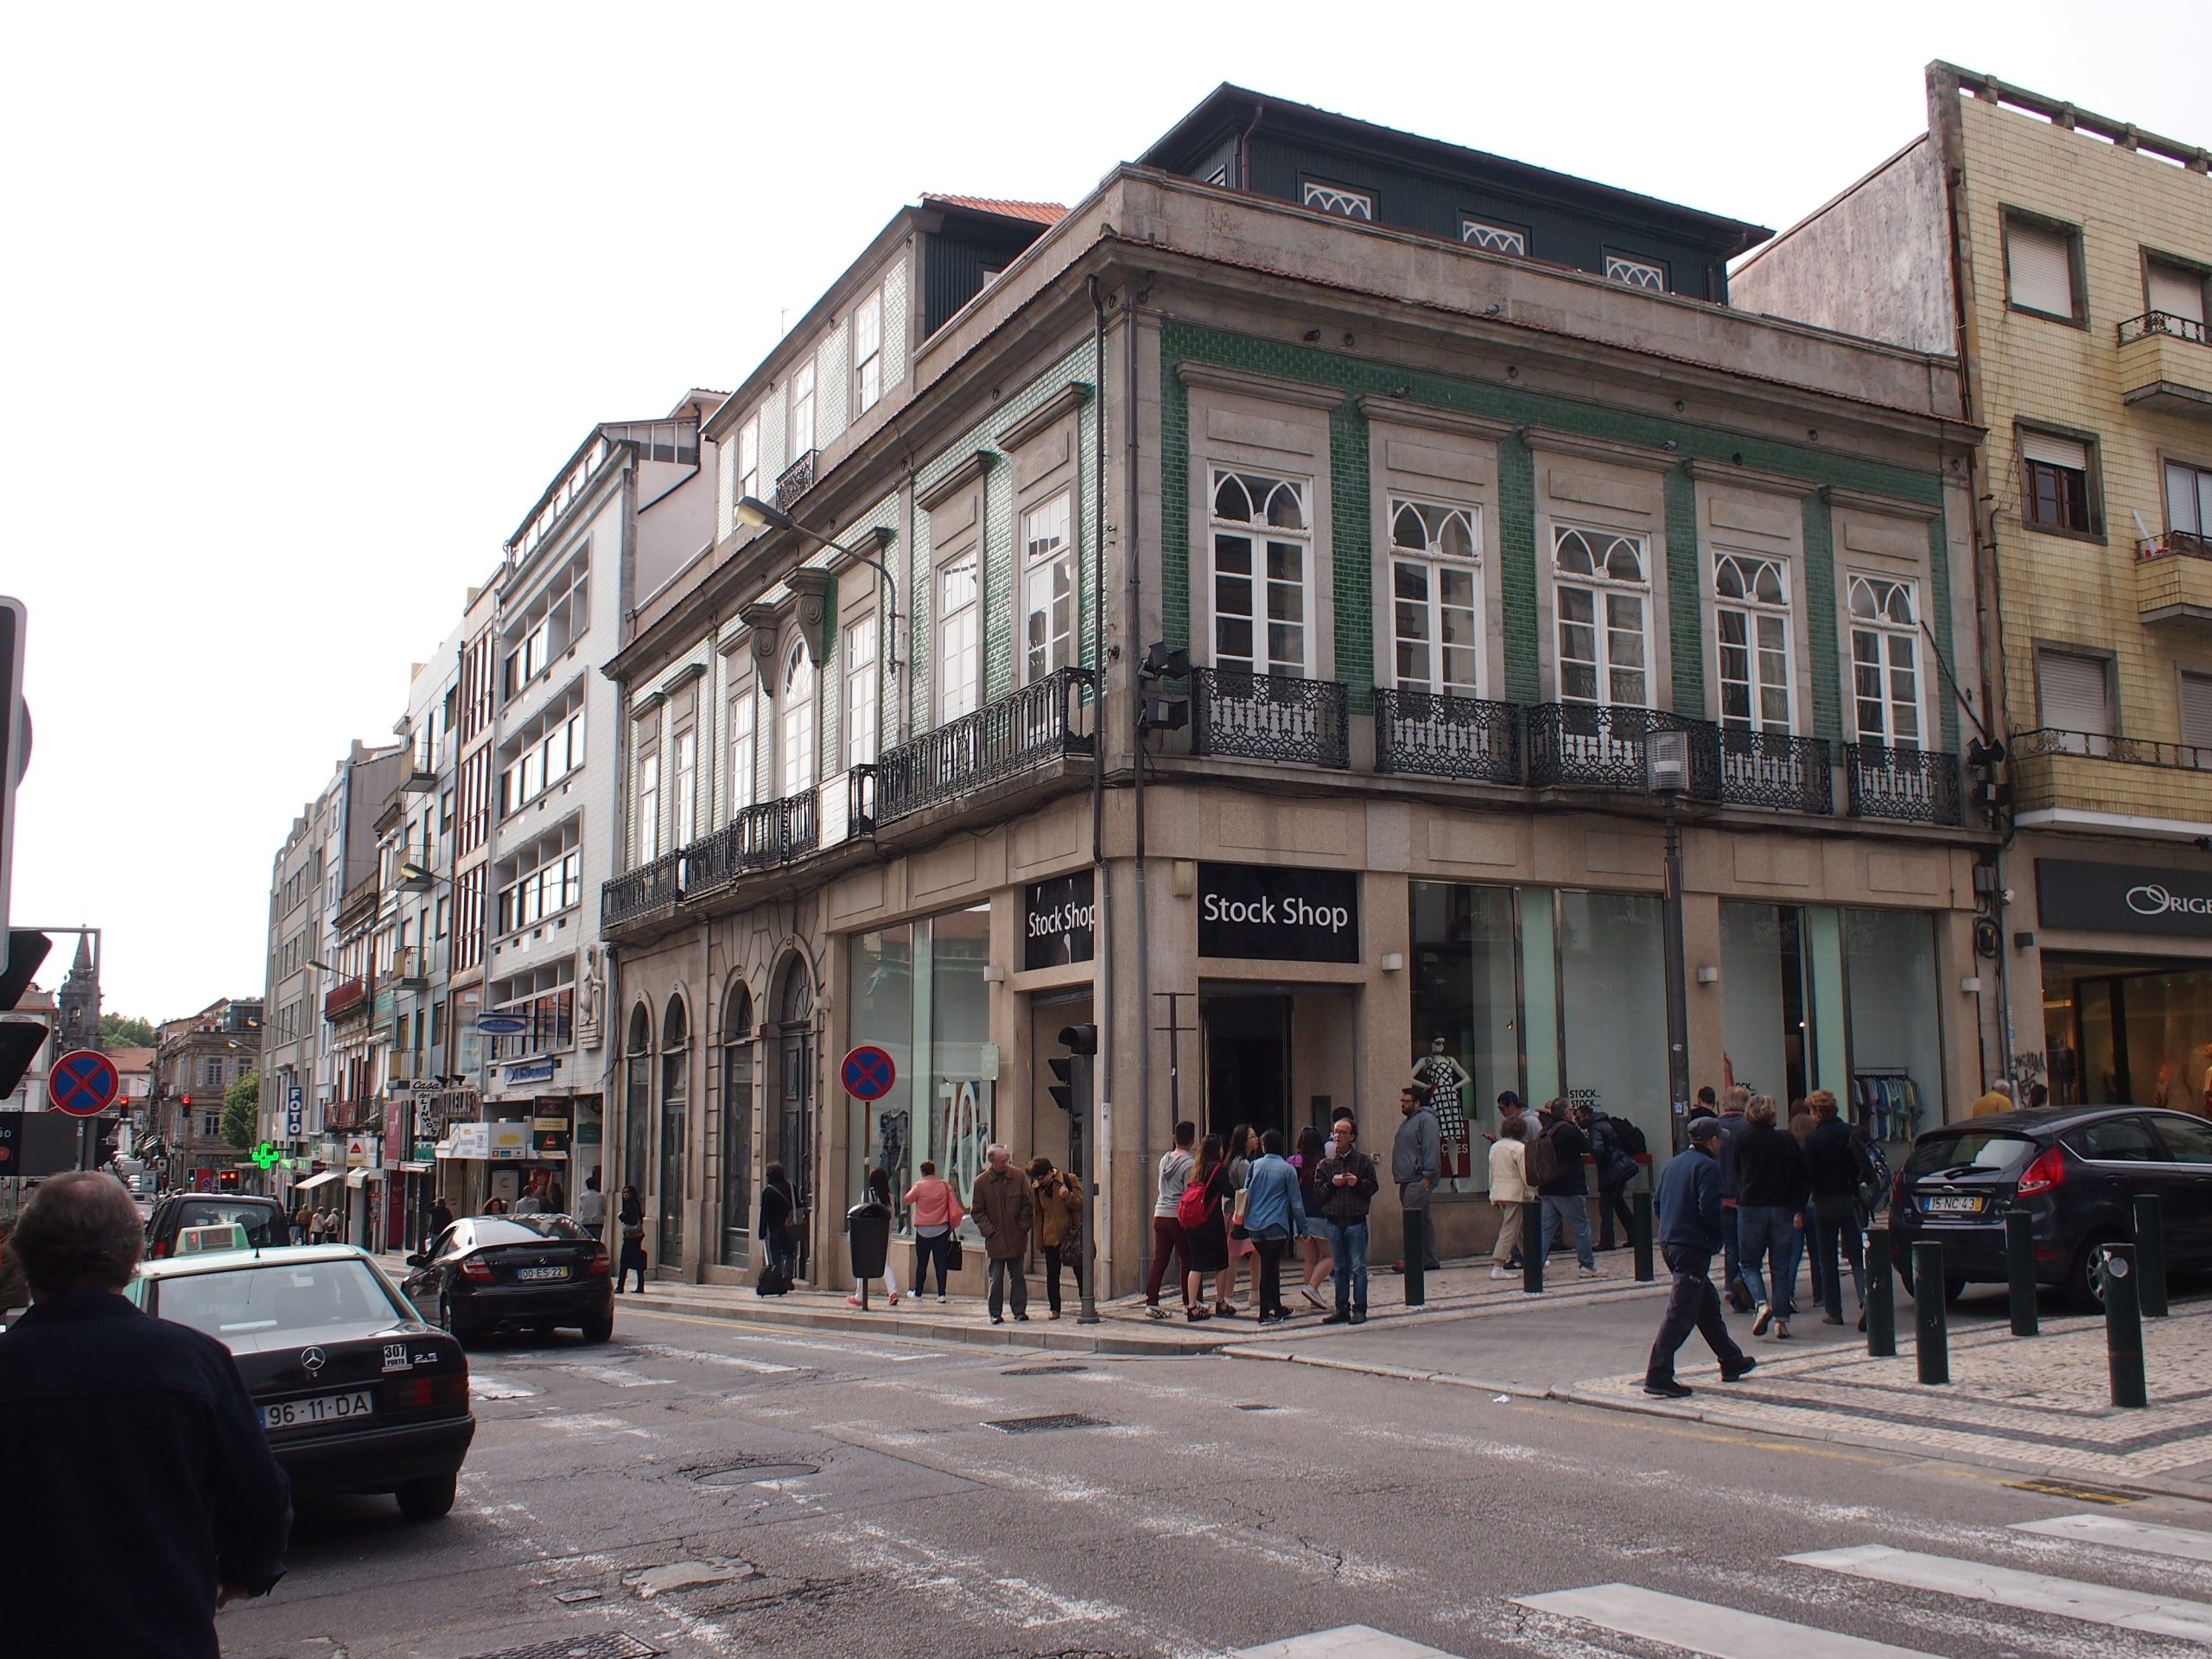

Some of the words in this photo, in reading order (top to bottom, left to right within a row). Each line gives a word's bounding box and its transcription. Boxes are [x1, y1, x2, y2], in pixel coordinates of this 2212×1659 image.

[1028, 906, 1062, 938] Stock
[1065, 901, 1095, 932] Shop
[1204, 893, 1277, 924] Stock
[1282, 897, 1348, 933] Shop
[413, 1080, 440, 1090] Casa
[289, 1089, 302, 1135] FOTO
[420, 1099, 436, 1135] LINHOS
[385, 1344, 405, 1358] 307
[414, 1352, 438, 1363] 2.5
